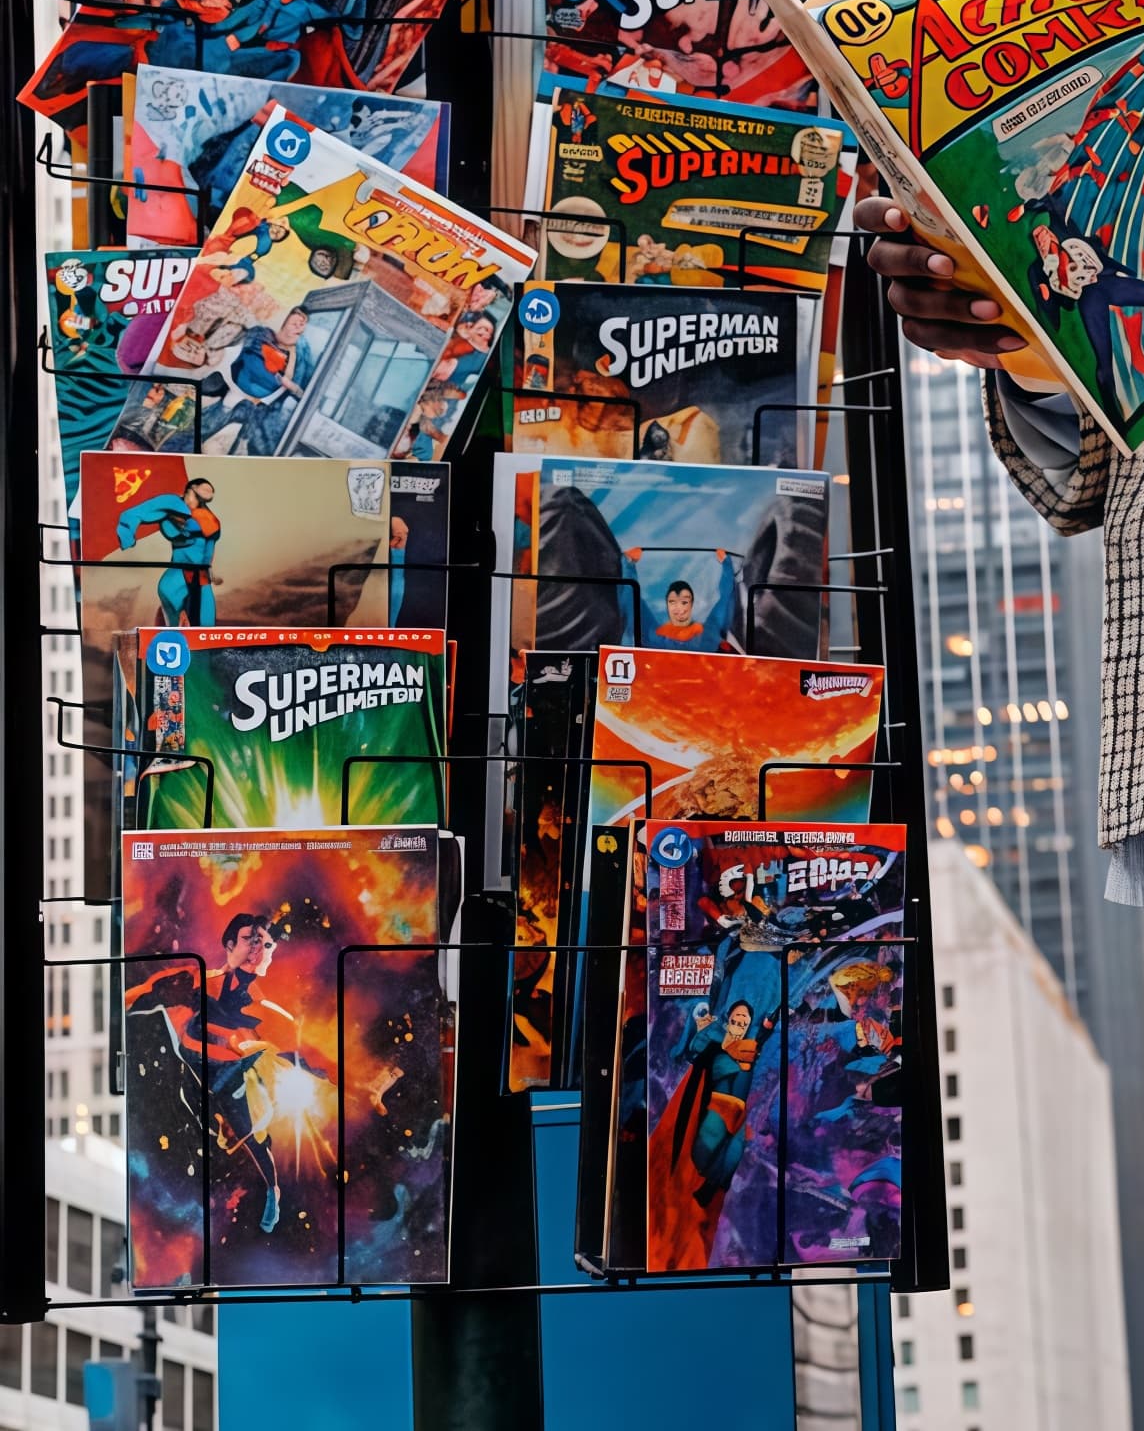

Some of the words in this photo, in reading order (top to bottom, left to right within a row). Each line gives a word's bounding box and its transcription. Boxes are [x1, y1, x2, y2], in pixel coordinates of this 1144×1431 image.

[100, 258, 193, 302] SUP
[597, 313, 779, 377] SUPERMAN
[231, 662, 424, 732] SUPERMAN
